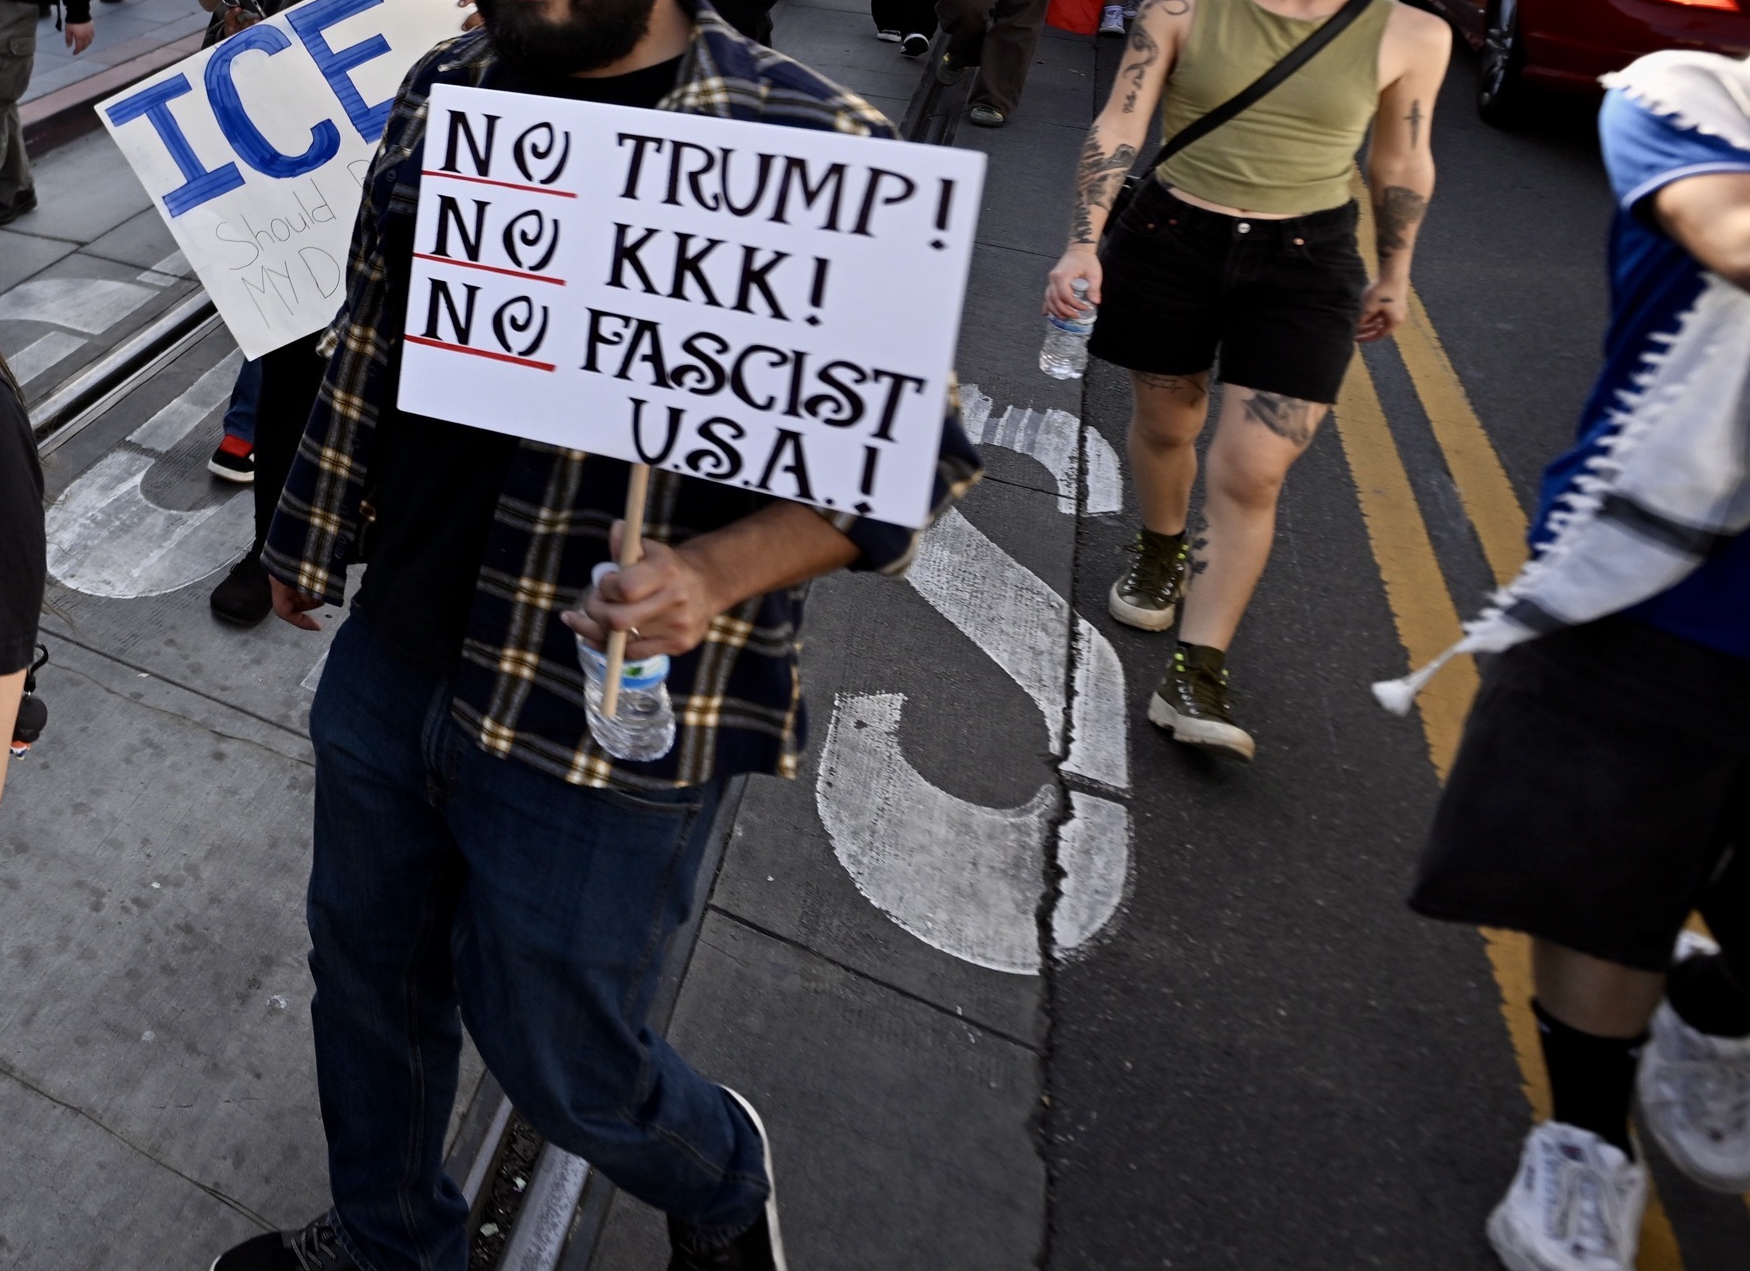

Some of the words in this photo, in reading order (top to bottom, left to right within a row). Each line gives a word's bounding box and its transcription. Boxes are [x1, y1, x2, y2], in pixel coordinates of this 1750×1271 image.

[215, 178, 337, 271] Should
[439, 109, 570, 185] NO
[615, 131, 958, 252] TRUMP!
[429, 194, 561, 272] NO
[605, 222, 833, 328] KKK!
[419, 277, 550, 358] NO
[579, 307, 927, 444] FASCIST
[629, 396, 884, 515] U.S.A.!
